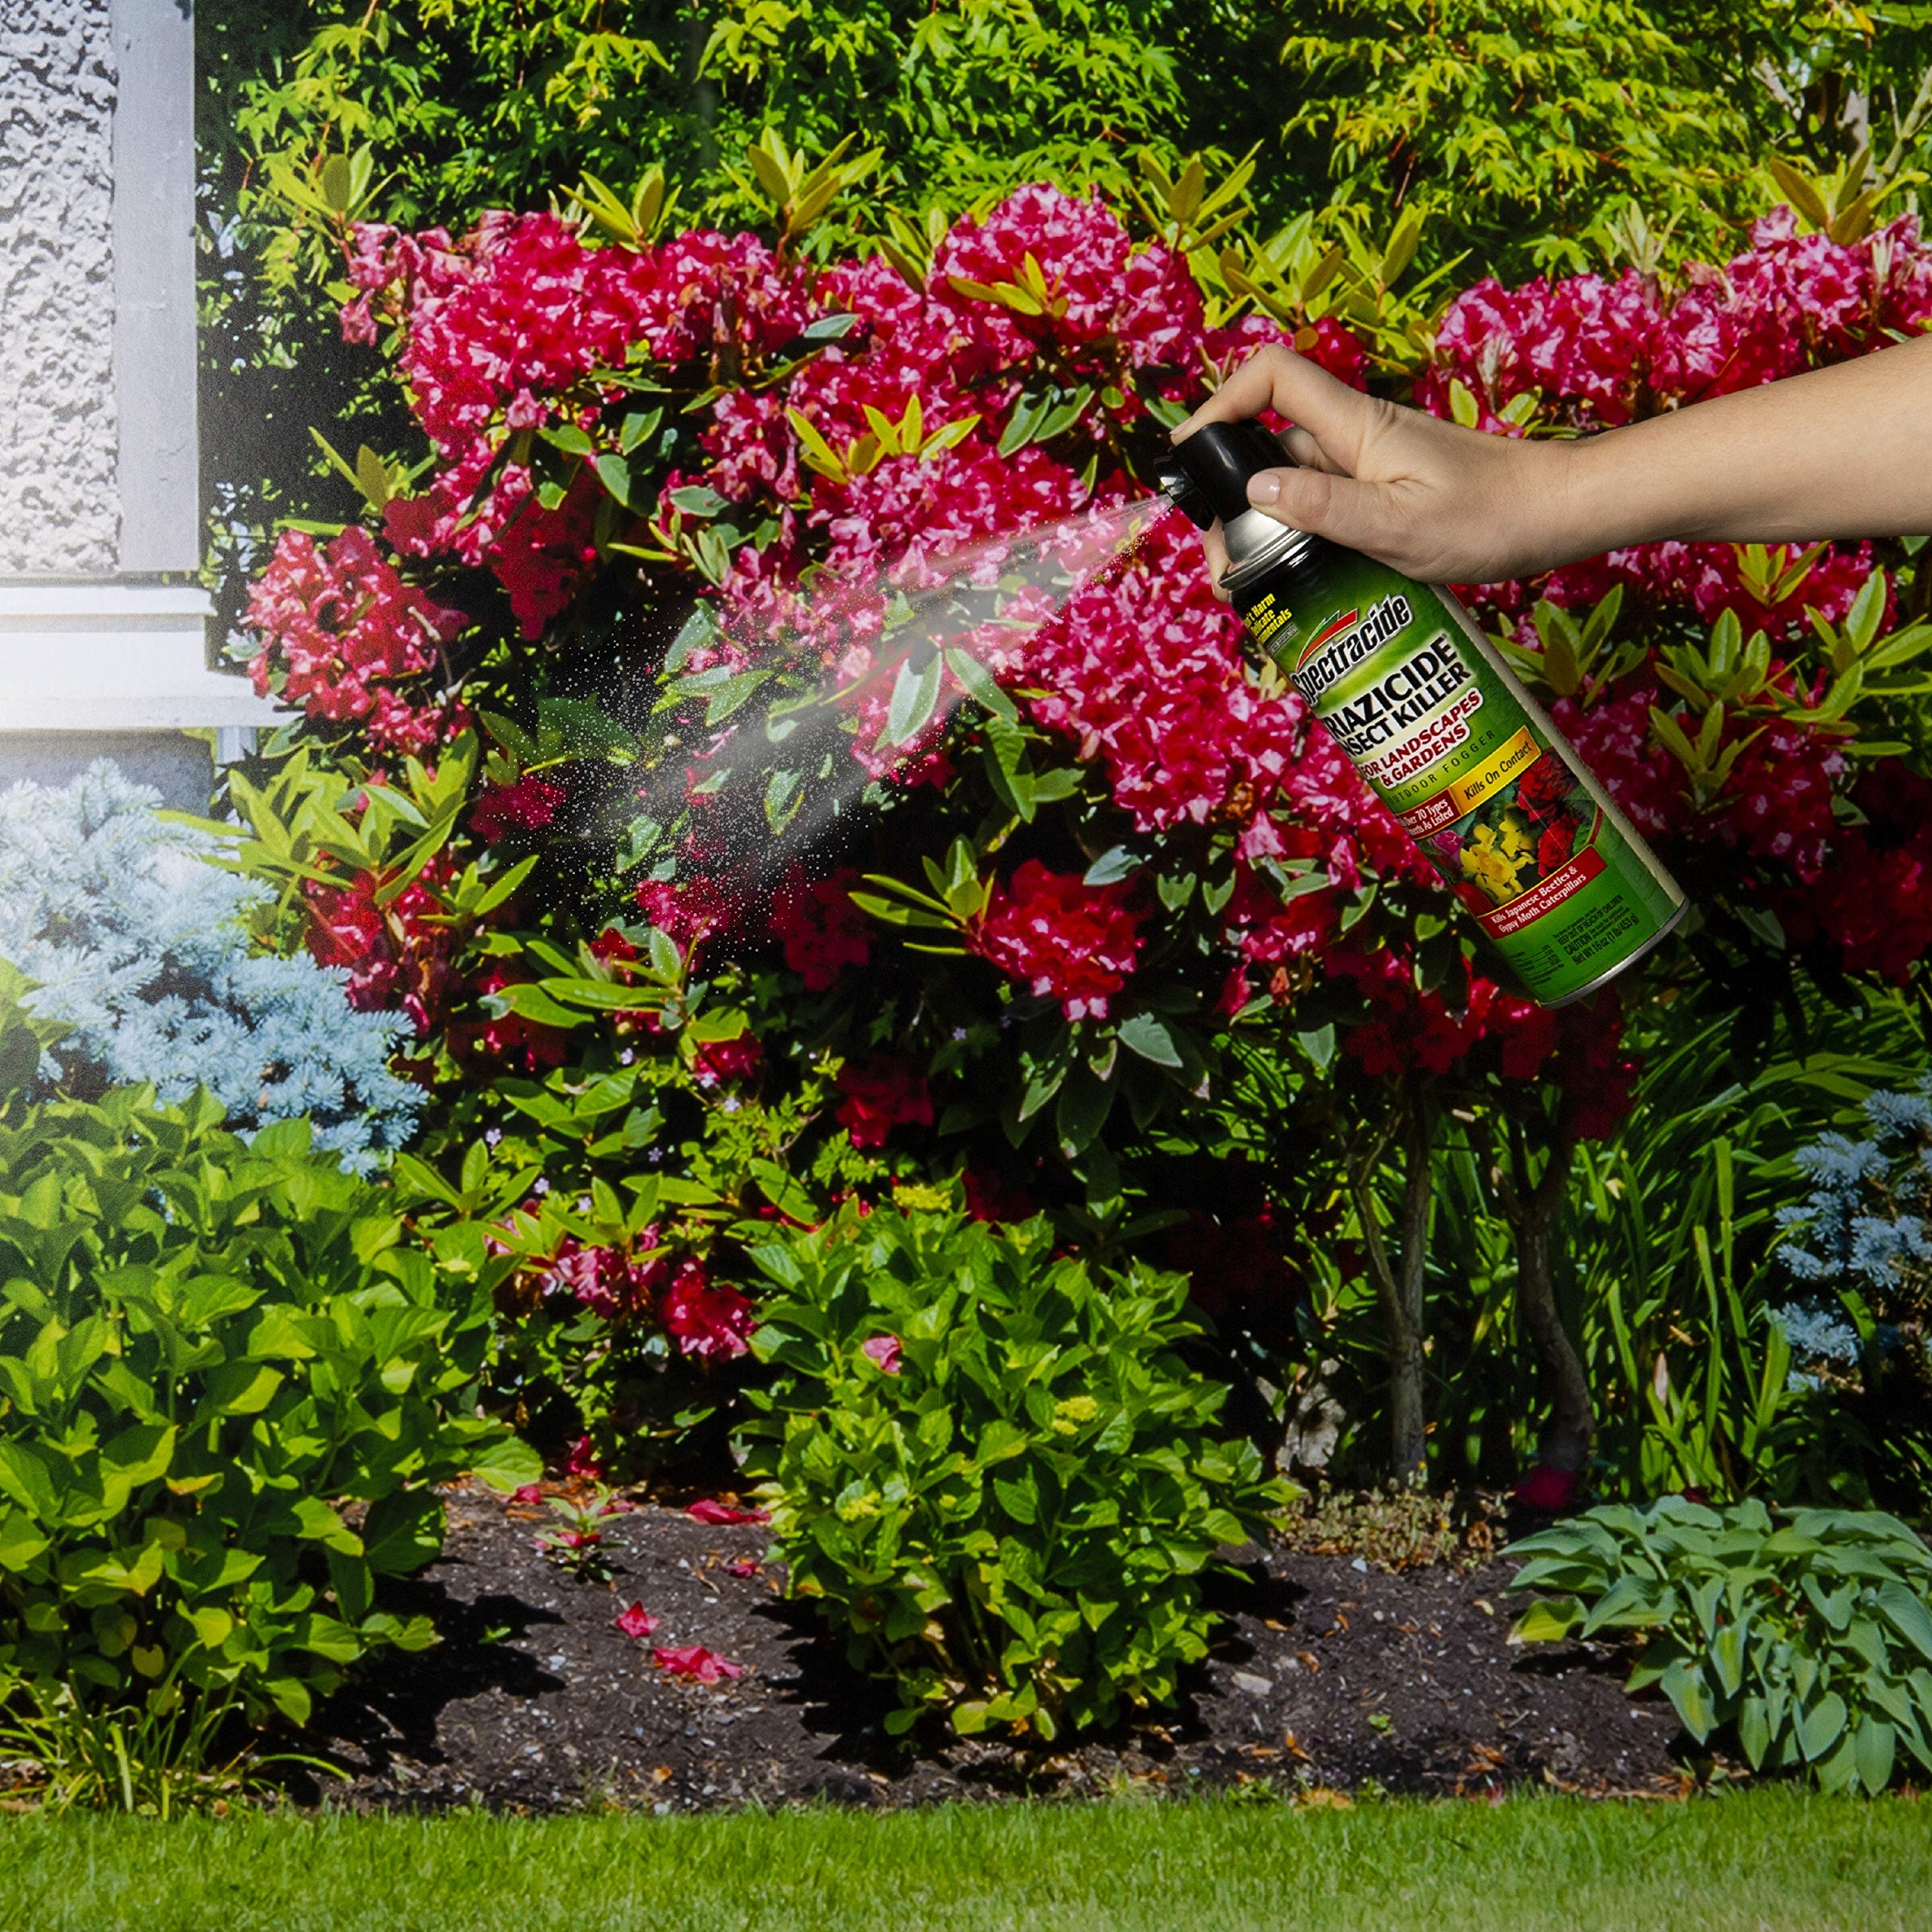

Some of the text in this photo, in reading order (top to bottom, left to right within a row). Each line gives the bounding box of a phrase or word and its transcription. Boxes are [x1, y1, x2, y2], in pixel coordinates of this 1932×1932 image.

[1251, 593, 1275, 617] Harm
[1291, 595, 1410, 704] Spectracide
[1322, 636, 1457, 739] RIAZICIDE
[1340, 661, 1471, 757] NSECT KILLER
[1361, 691, 1481, 777] FOR LANDSCAPES
[1381, 724, 1466, 786] & GARDENS
[1443, 730, 1495, 773] FOGGER
[1464, 741, 1532, 800] Kills On Contact
[1415, 808, 1427, 820] 70
[1425, 798, 1448, 817] Types
[1423, 821, 1432, 830] As
[1430, 807, 1454, 826] Listed
[1491, 866, 1578, 924] Kills Japanese Beetles &
[1498, 918, 1519, 933] Gypsy
[1517, 907, 1540, 923] Moth
[1539, 874, 1586, 909] Caterpillars
[1564, 931, 1593, 955] CAUTION
[1571, 952, 1586, 965] Net
[1592, 940, 1603, 952] 16
[1601, 937, 1610, 947] oz
